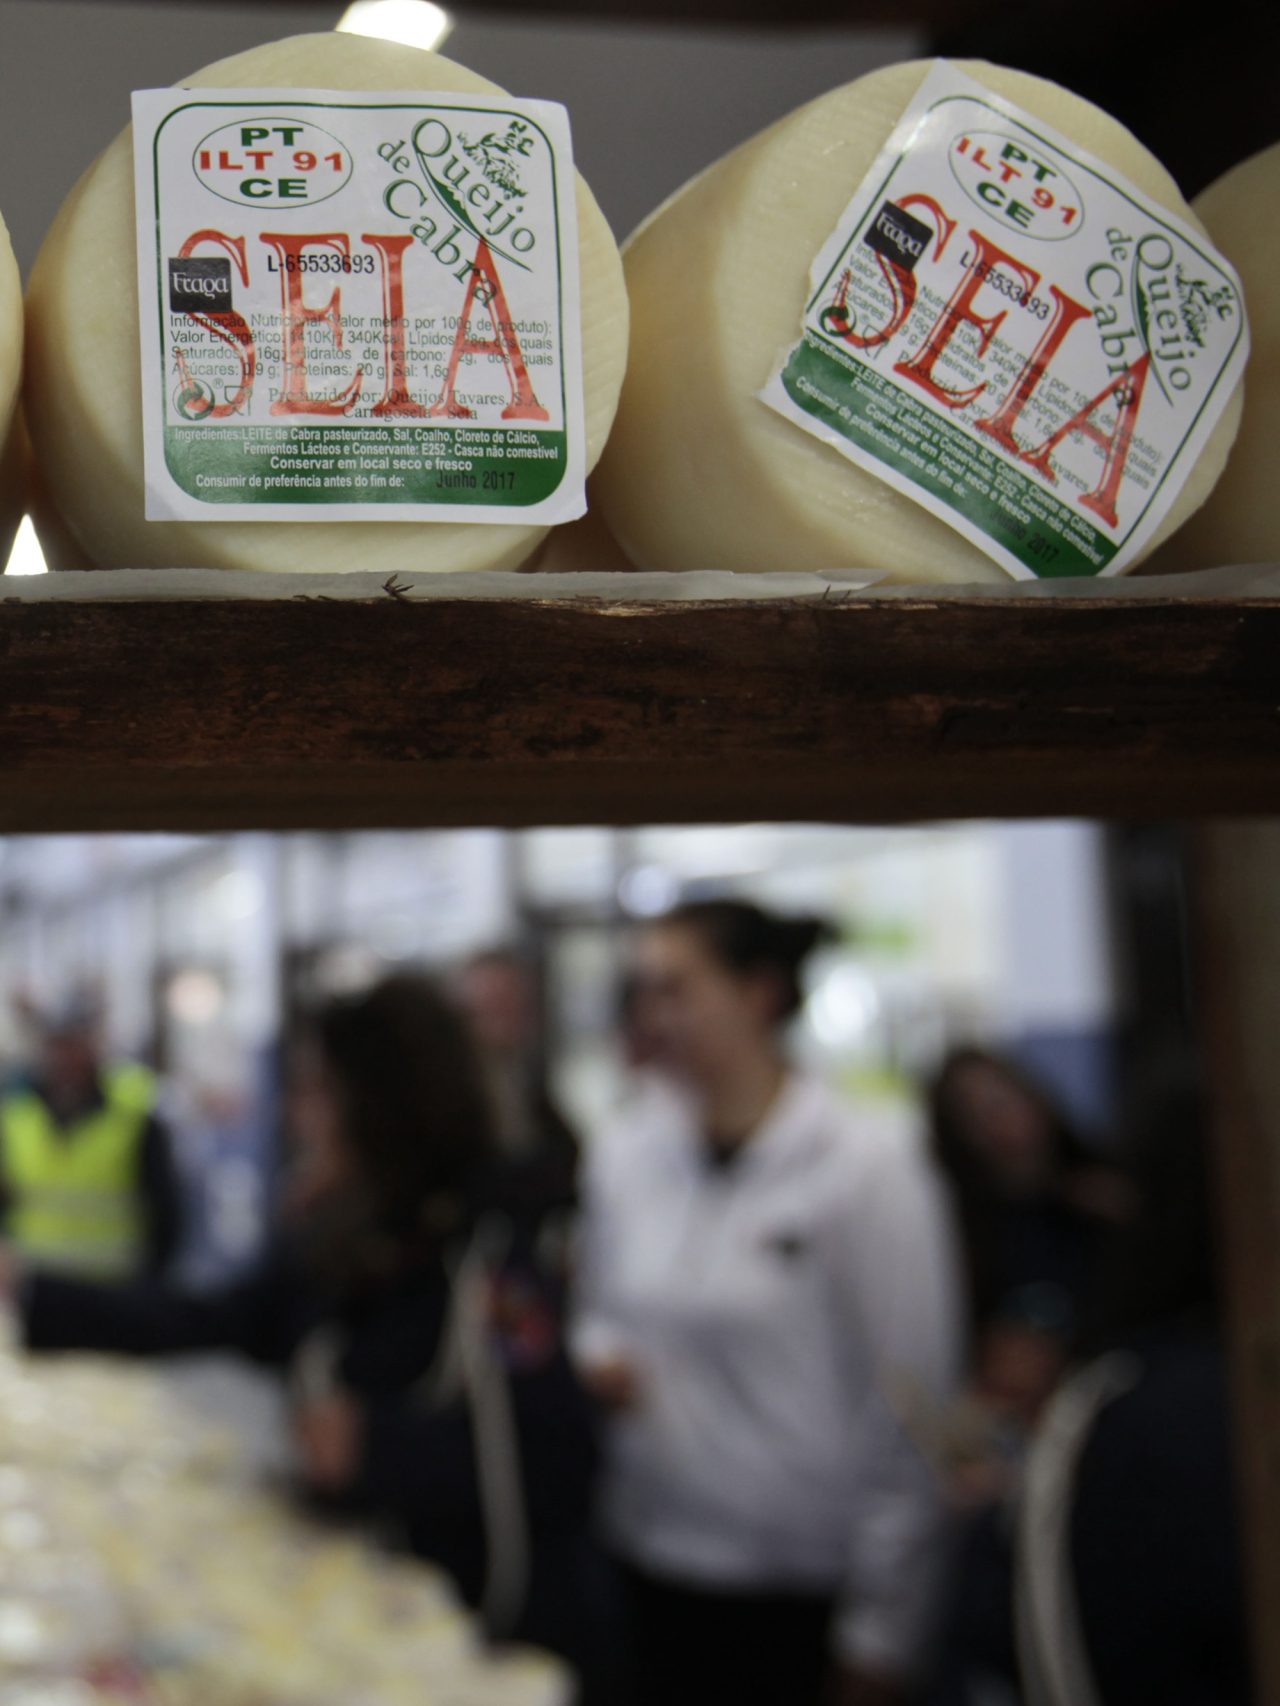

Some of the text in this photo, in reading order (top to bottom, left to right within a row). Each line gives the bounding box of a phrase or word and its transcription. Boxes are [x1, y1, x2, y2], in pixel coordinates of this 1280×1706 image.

[240, 127, 303, 147] PT
[200, 151, 344, 172] ILT 91
[1000, 142, 1057, 183] PT
[239, 178, 308, 199] CE
[411, 118, 535, 253] Queijo
[956, 137, 1077, 225] ILT 91
[977, 182, 1035, 229] CE
[377, 138, 497, 308] de Cabra
[267, 254, 375, 275] L-65533693
[173, 271, 229, 299] Fraga
[174, 229, 550, 422] SEIA
[1086, 226, 1135, 408] de Cabra
[1135, 232, 1192, 393] Queijo
[836, 193, 1151, 529] SEIA
[244, 442, 298, 455] Fermentos
[301, 442, 341, 455] Lácteos
[344, 445, 349, 455] e
[352, 442, 418, 456] Conservante:
[422, 443, 446, 456] E252
[455, 444, 483, 457] Casca
[486, 446, 504, 458] não
[270, 457, 472, 471] Conservar em local seco e fresco
[196, 474, 405, 489] Consumir de preferência antes do fim de:
[437, 471, 515, 490] Junho 2017
